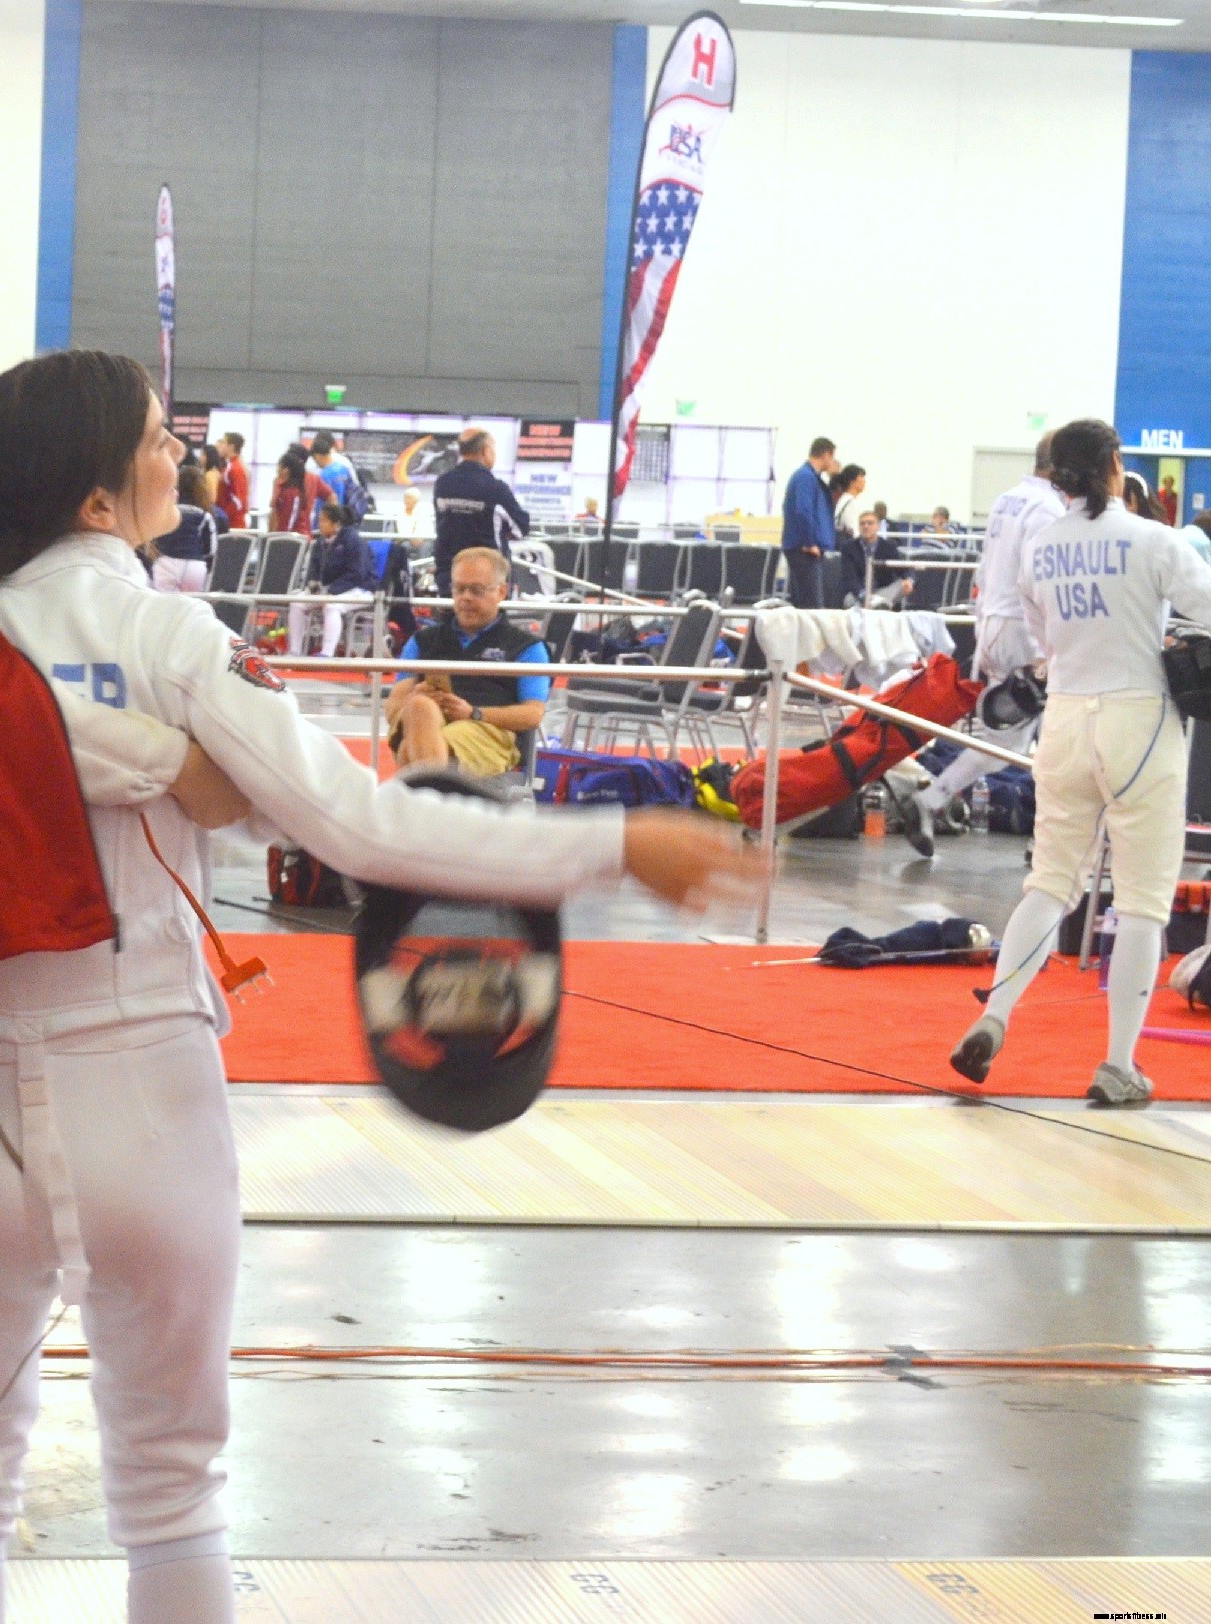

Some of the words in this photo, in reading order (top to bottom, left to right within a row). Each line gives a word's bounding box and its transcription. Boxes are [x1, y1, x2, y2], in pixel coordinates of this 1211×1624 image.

[691, 32, 718, 87] H
[1141, 429, 1184, 448] MEN
[1033, 540, 1132, 580] ESNAULT
[1055, 582, 1110, 621] USA
